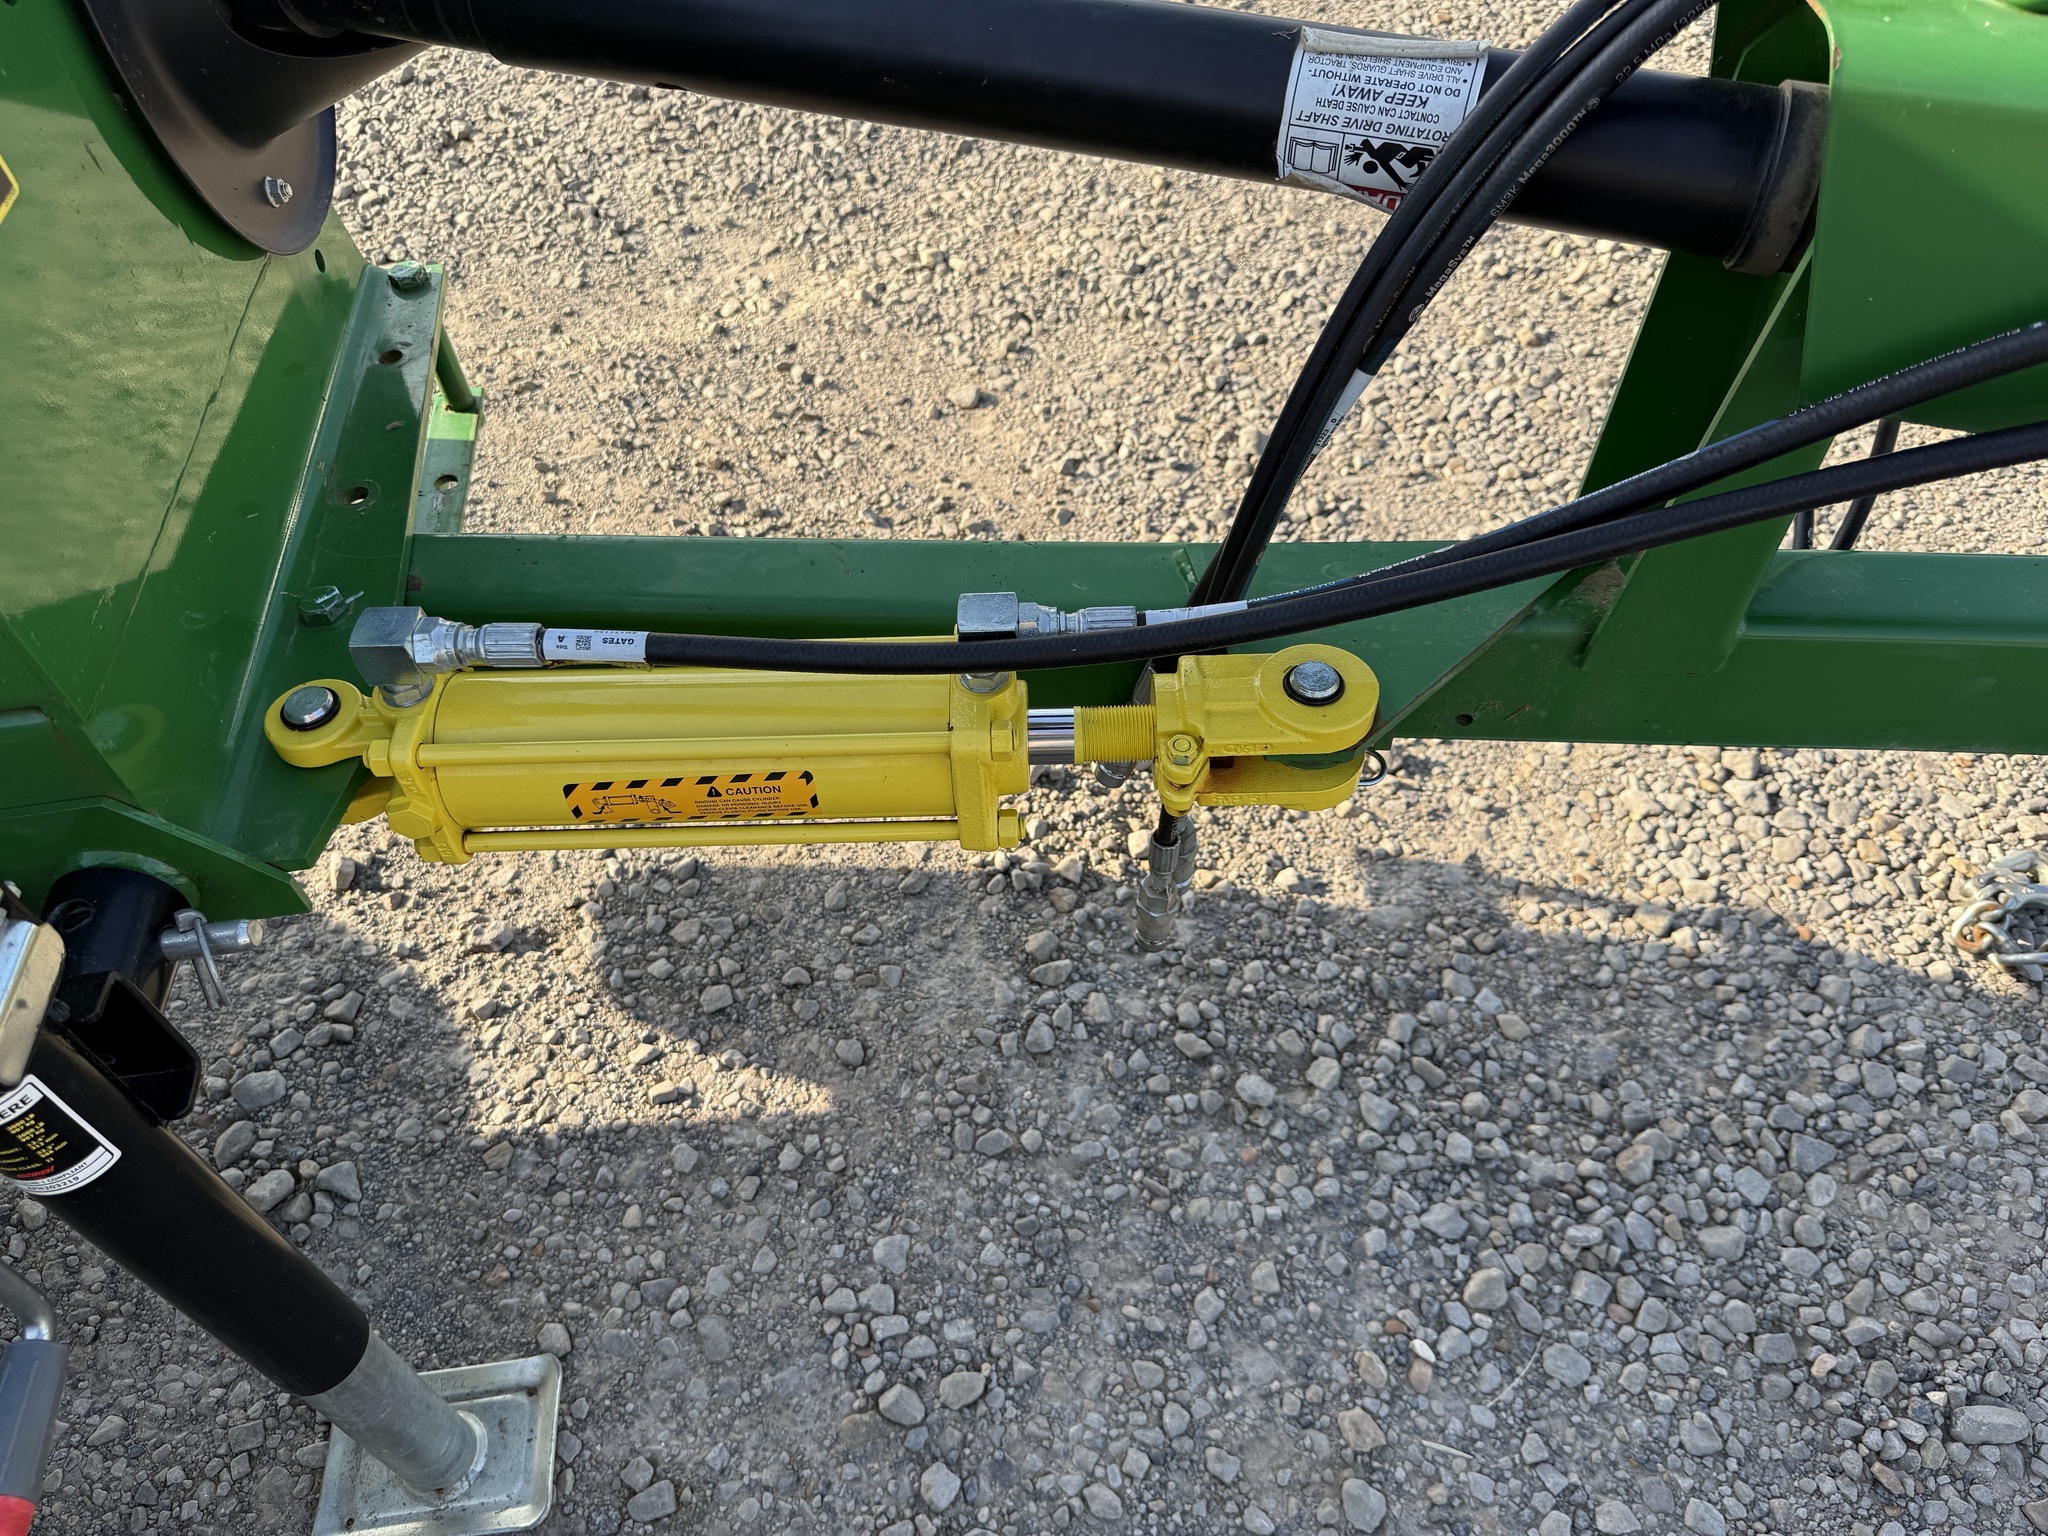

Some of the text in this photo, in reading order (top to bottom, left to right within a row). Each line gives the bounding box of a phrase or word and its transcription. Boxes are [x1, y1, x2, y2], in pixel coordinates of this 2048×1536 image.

[1643, 32, 1673, 57] MPa
[1308, 56, 1346, 68] TRACTOR
[1393, 60, 1443, 72] EQUIPMENT
[1388, 68, 1416, 78] SHAFT
[1418, 72, 1443, 82] DRIVE
[1445, 67, 1463, 75] AND
[1364, 76, 1415, 90] OPERATE
[1446, 75, 1461, 84] ALL
[1418, 84, 1441, 94] NOT
[1445, 88, 1460, 97] DO
[1331, 84, 1429, 109] KEEP AWAY!
[1316, 97, 1439, 124] CONTACT CAN CAUSE DEATH
[1296, 110, 1452, 142] ROTATING DRIVE SHAFT
[602, 637, 634, 645] GATES
[726, 786, 781, 795] CAUTION
[0, 1094, 33, 1119] ERE
[47, 1162, 88, 1182] COMPLIANT
